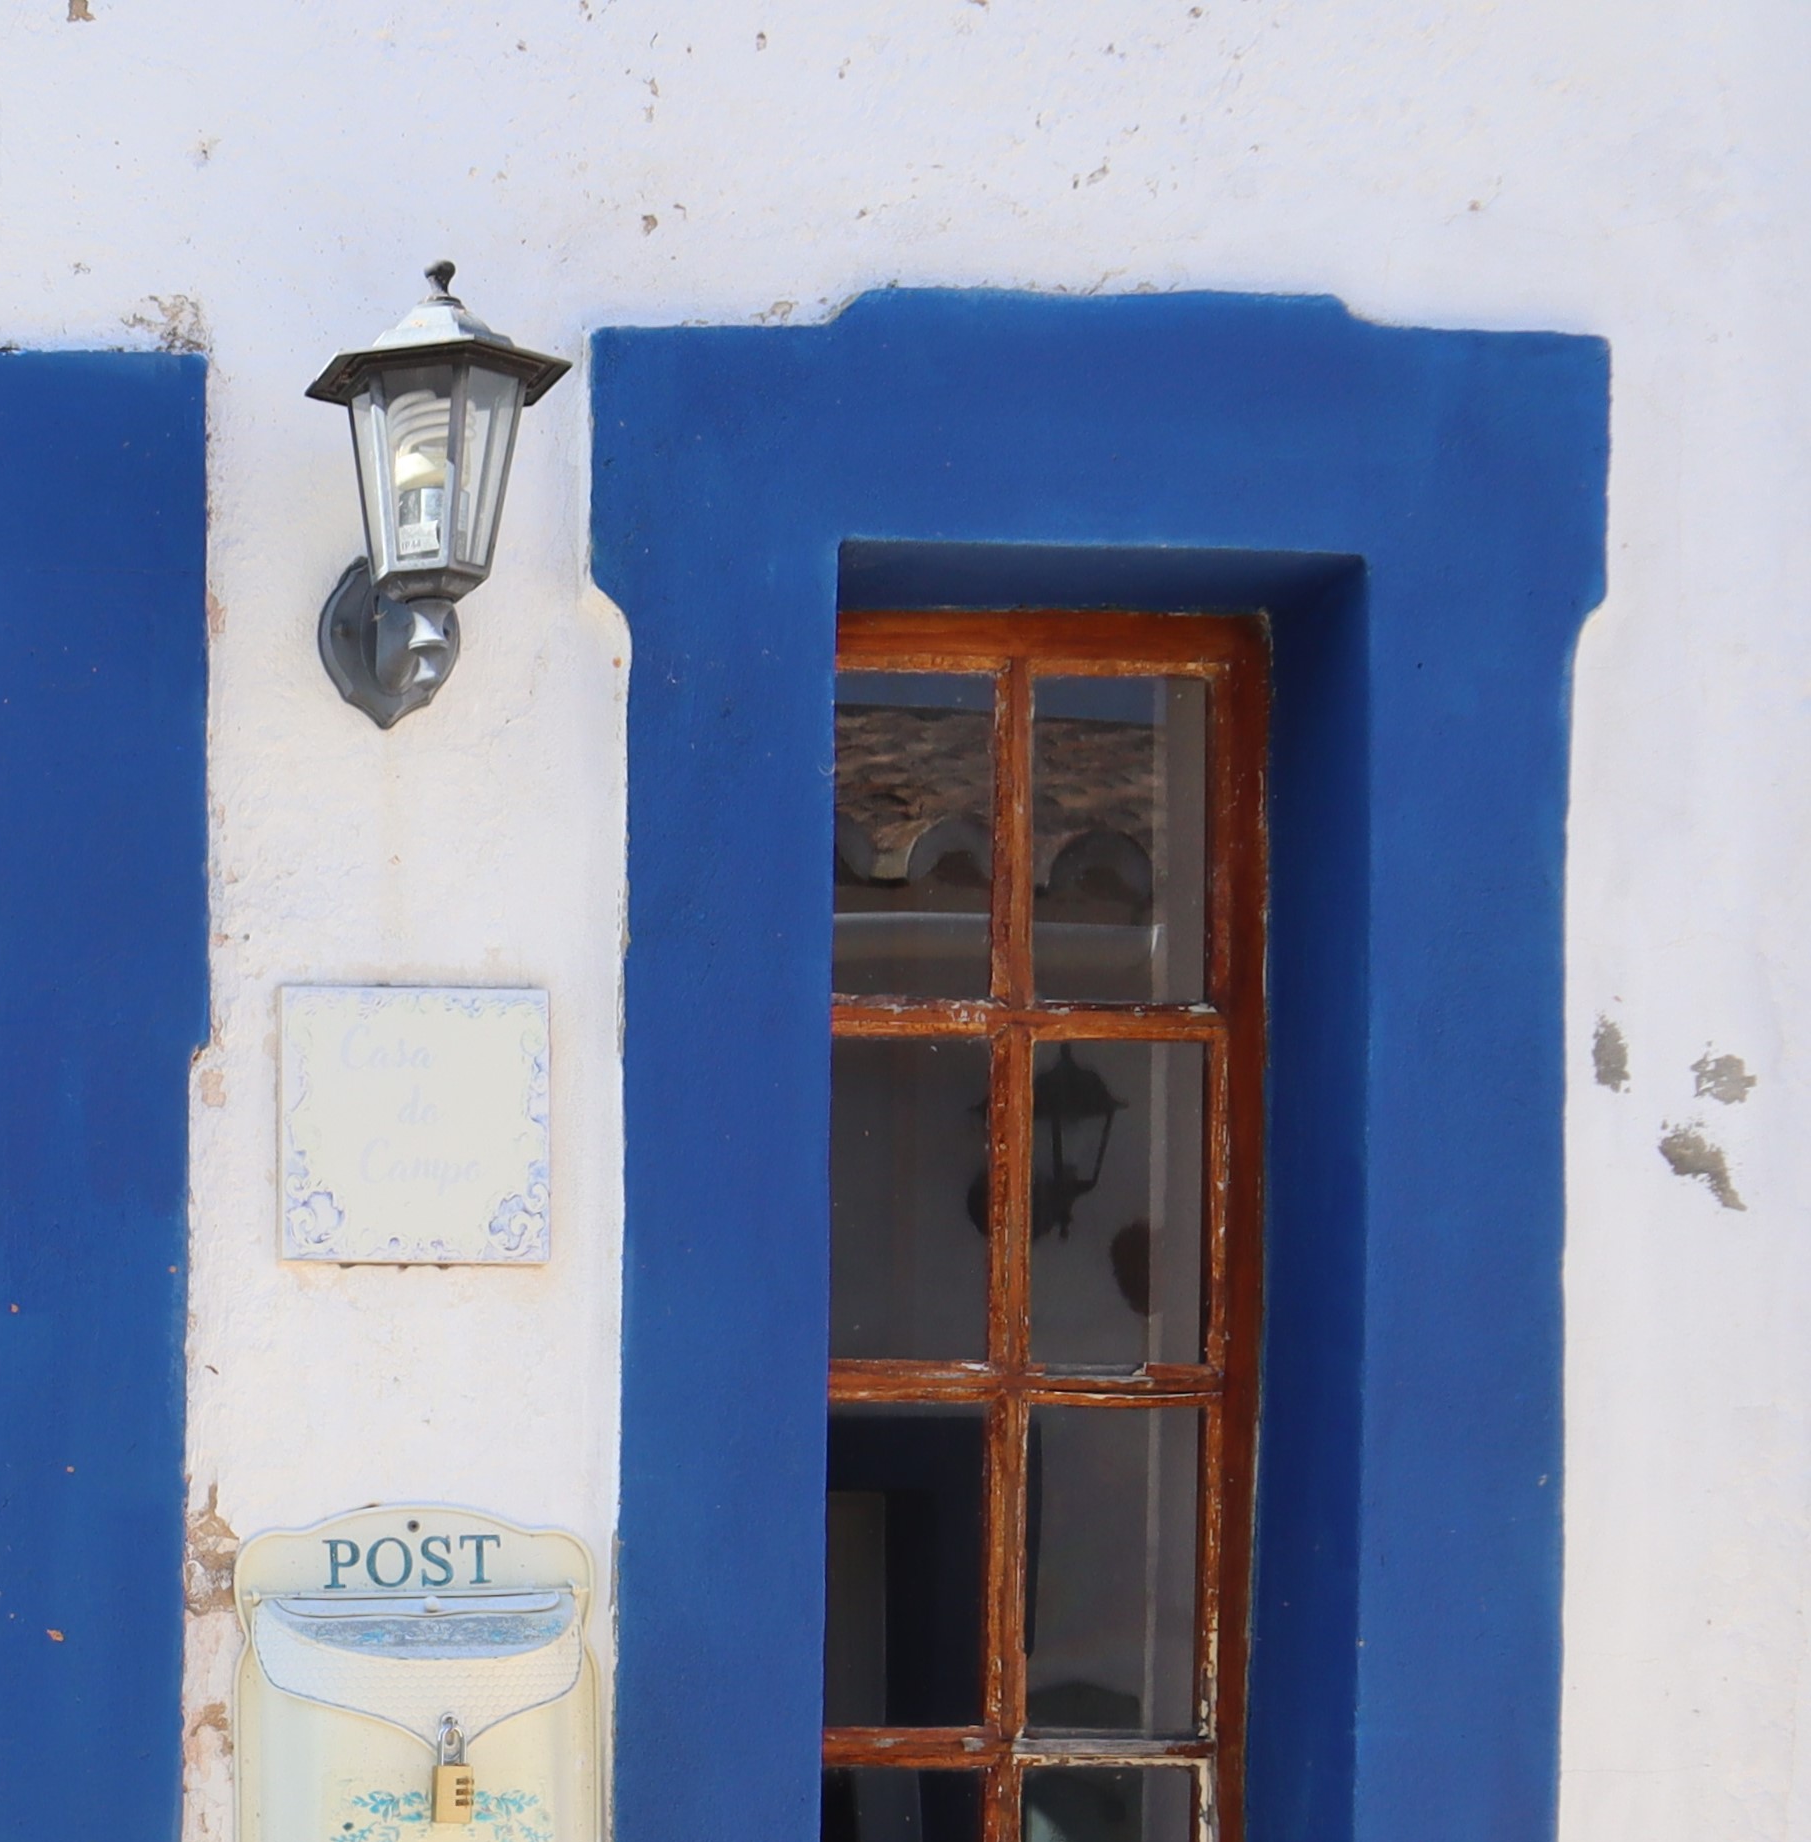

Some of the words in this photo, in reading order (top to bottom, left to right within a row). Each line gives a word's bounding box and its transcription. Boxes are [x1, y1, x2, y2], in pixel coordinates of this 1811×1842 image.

[340, 1024, 434, 1069] Casa
[359, 1137, 484, 1196] Campo
[322, 1534, 501, 1589] POST
